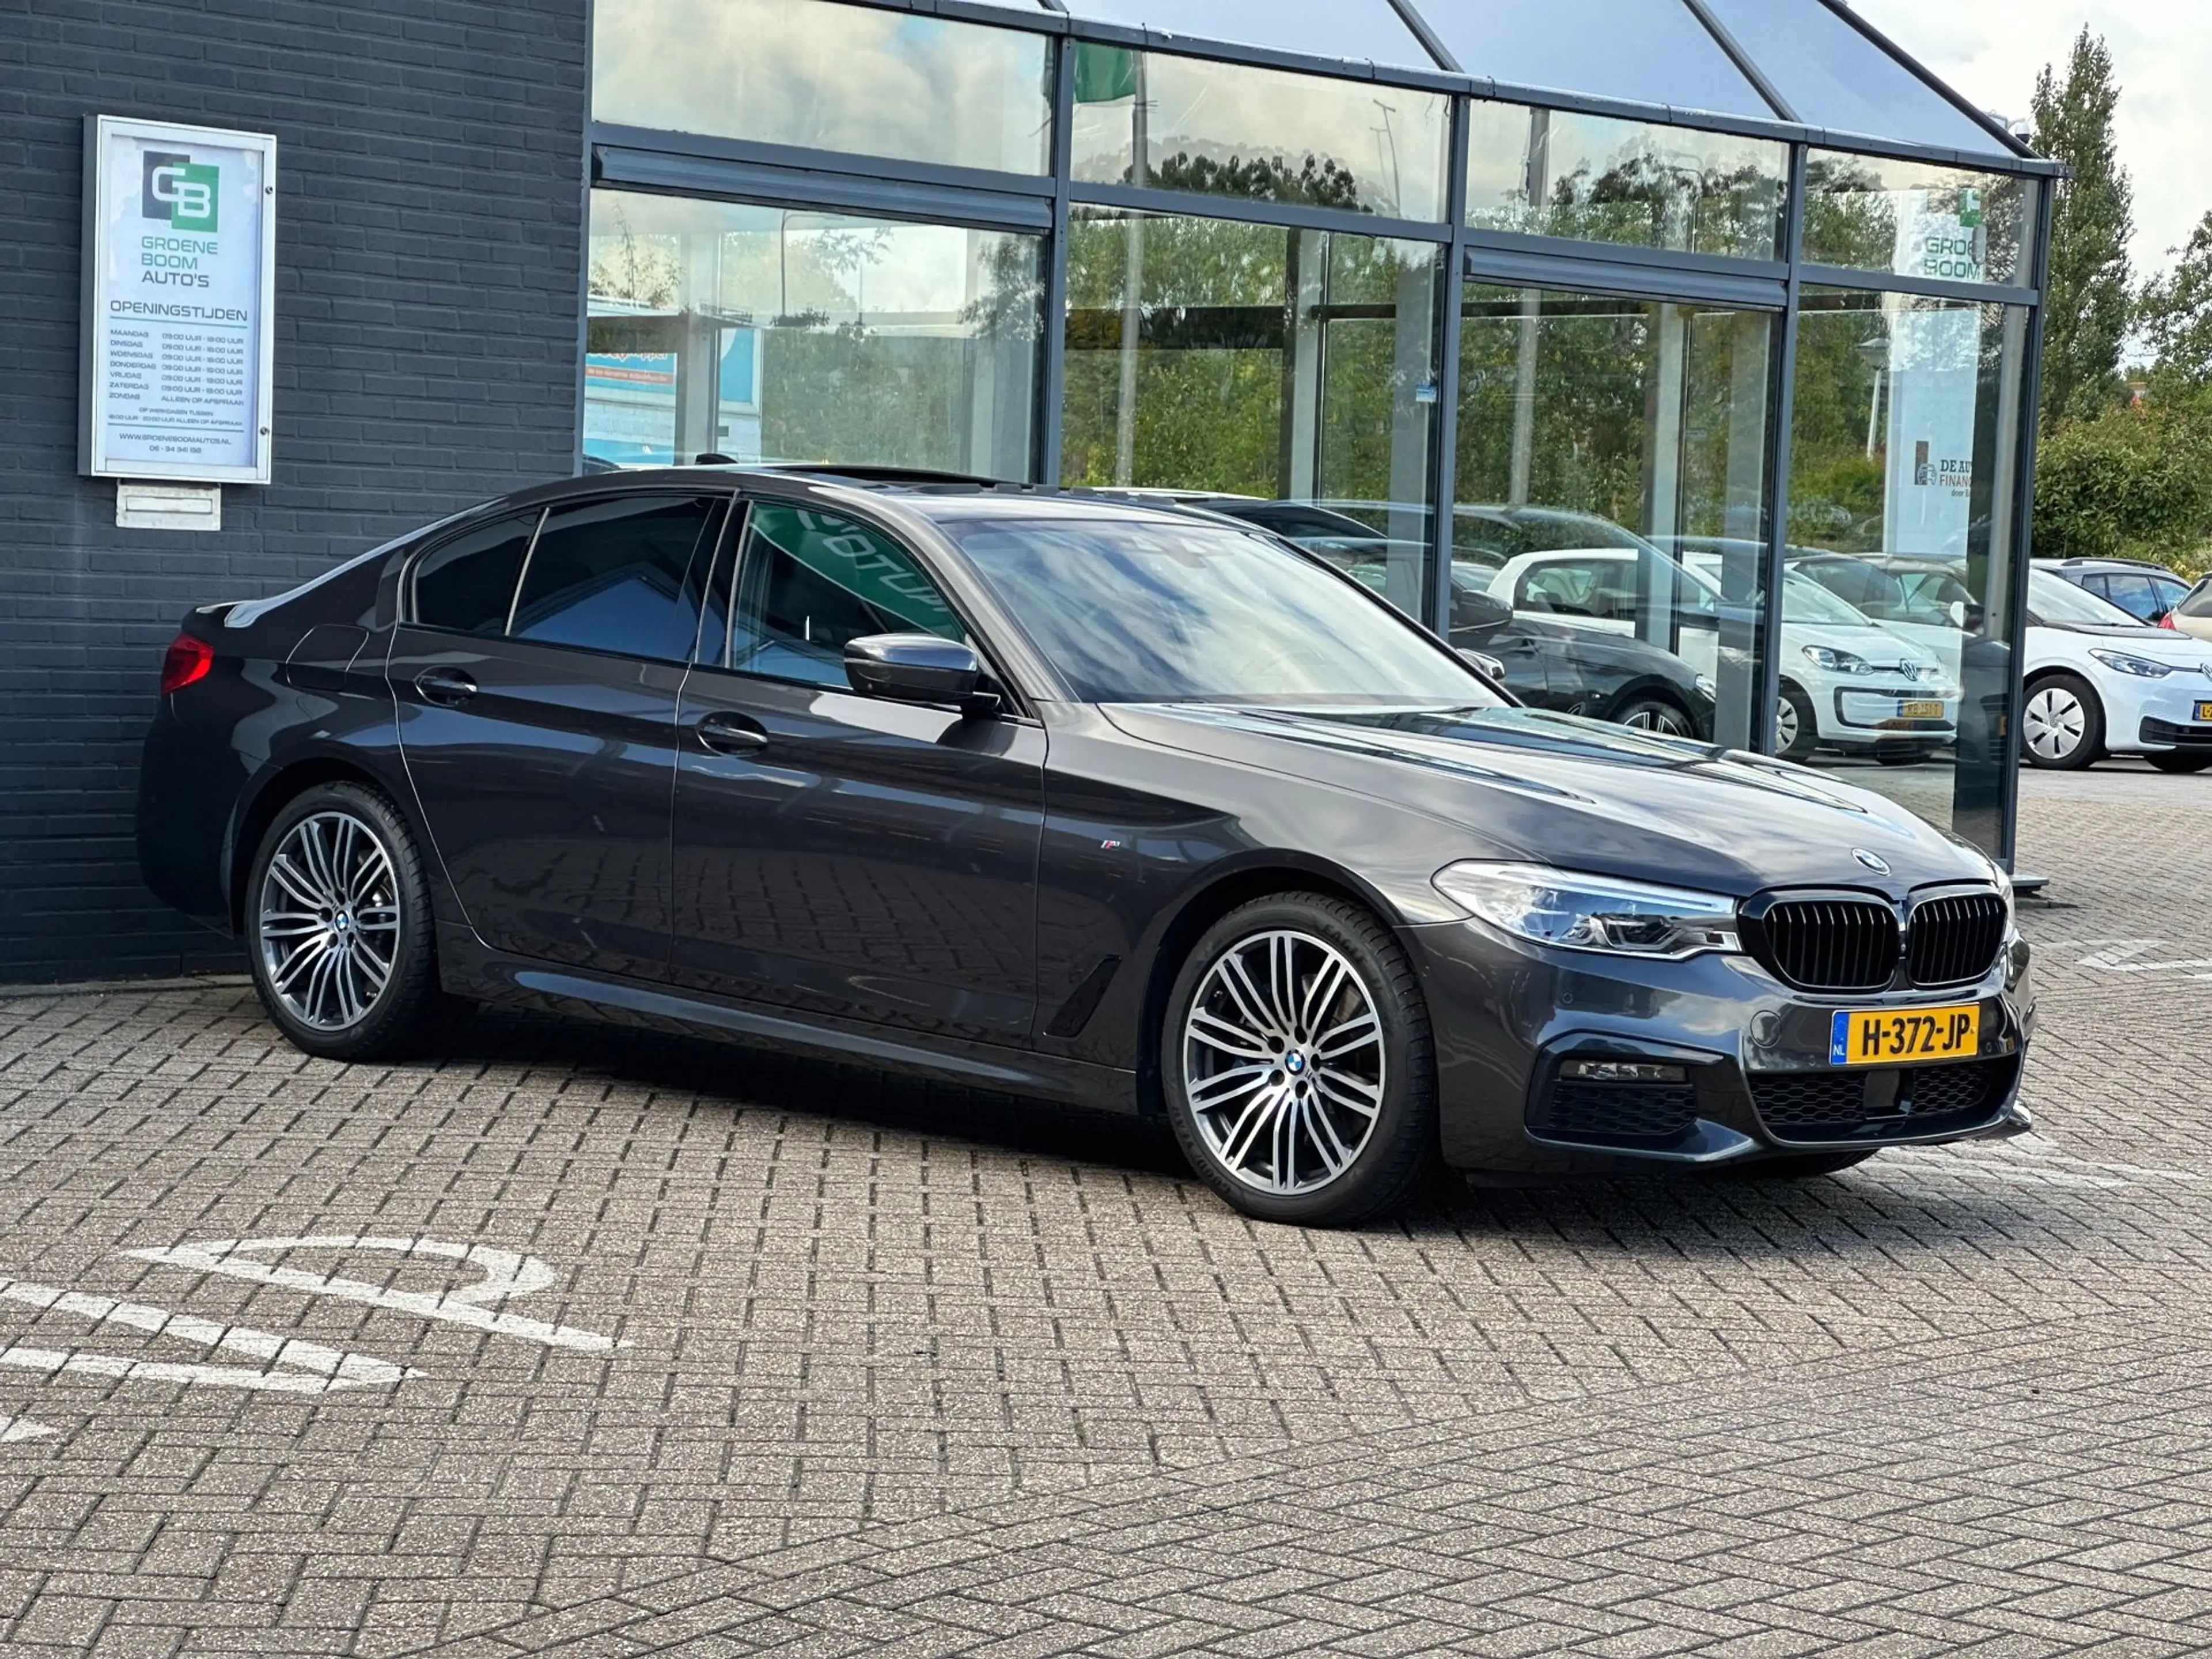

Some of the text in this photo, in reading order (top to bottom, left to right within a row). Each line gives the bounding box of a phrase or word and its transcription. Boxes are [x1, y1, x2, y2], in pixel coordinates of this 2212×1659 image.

[142, 236, 218, 255] GROENE
[142, 253, 198, 270] BOOM
[142, 271, 209, 287] AUTO'S
[111, 300, 247, 321] OPENINGSTIJDEN
[111, 329, 149, 338] MAANDAG
[109, 371, 142, 379] VRIJDAG
[109, 381, 149, 390] ZATERDAG
[1940, 459, 1957, 472] DE
[1862, 1013, 1970, 1056] H-372-JP
[1833, 1044, 1845, 1055] NL
